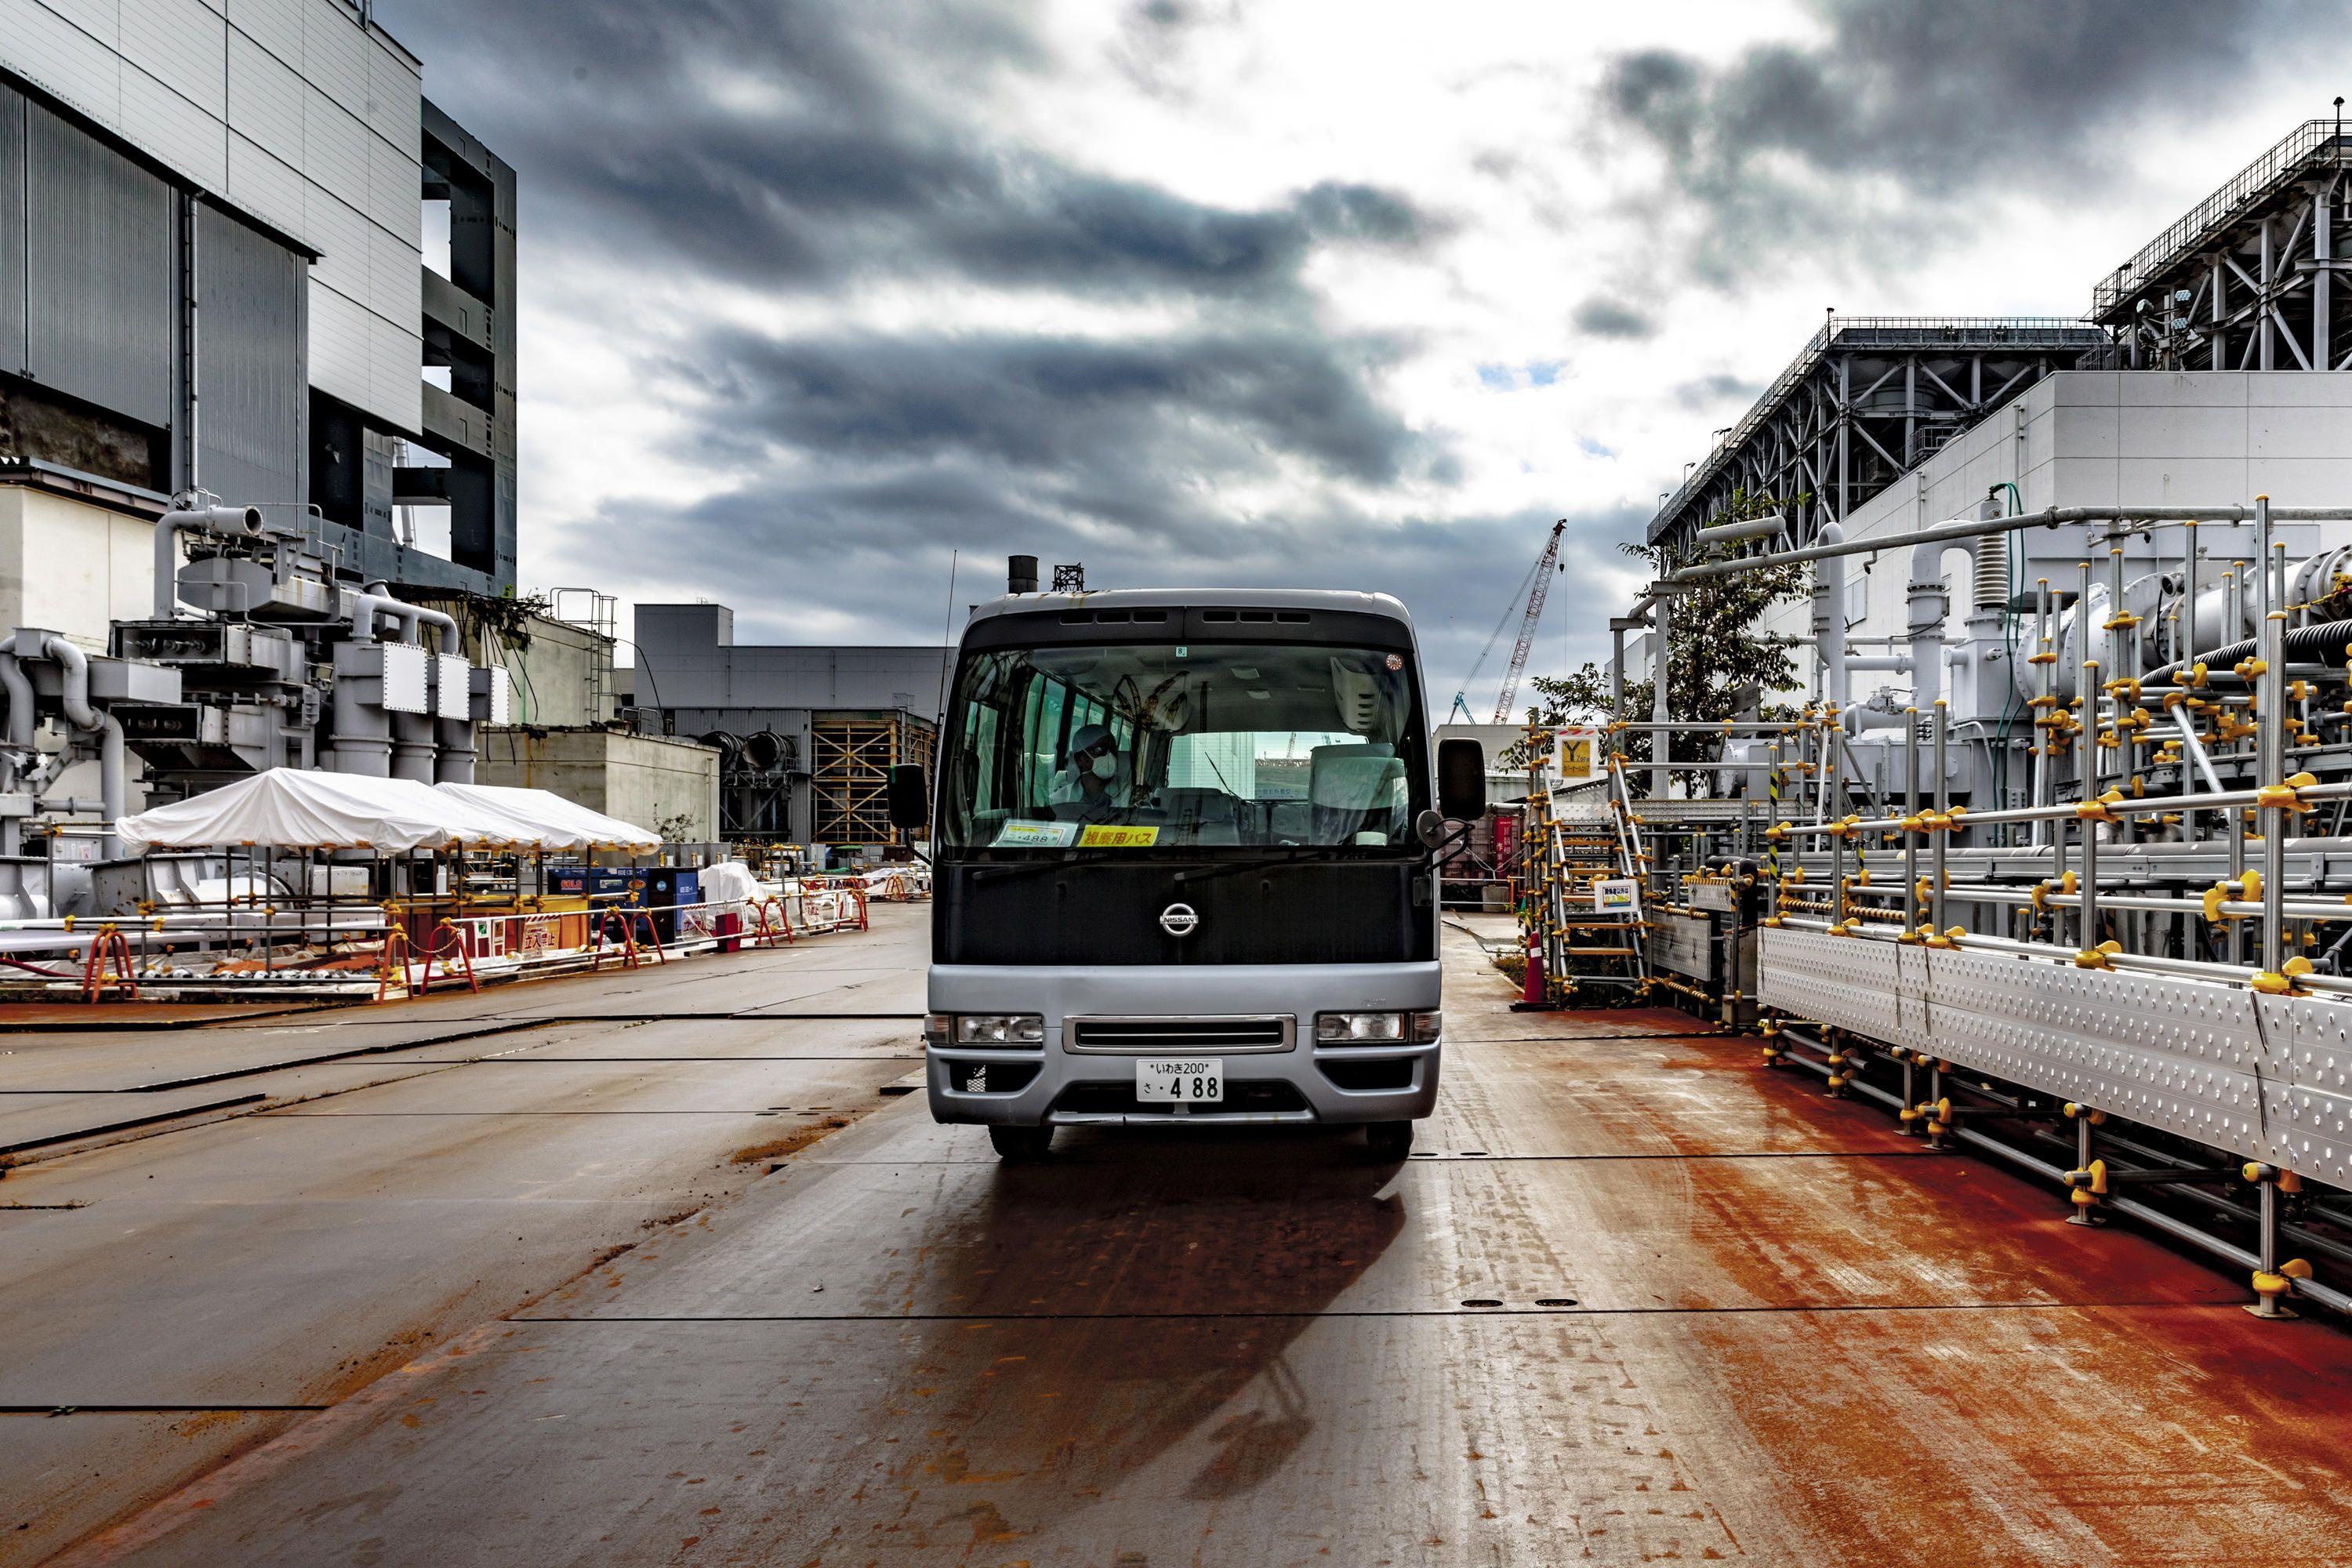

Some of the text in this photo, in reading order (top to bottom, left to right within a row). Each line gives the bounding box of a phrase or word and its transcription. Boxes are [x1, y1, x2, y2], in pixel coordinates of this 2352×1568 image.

[1563, 740, 1581, 761] Y
[1083, 831, 1152, 846] 視察用バス
[524, 932, 555, 949] 立入禁止
[1156, 1062, 1204, 1074] いわき200
[1144, 1082, 1151, 1094] さ
